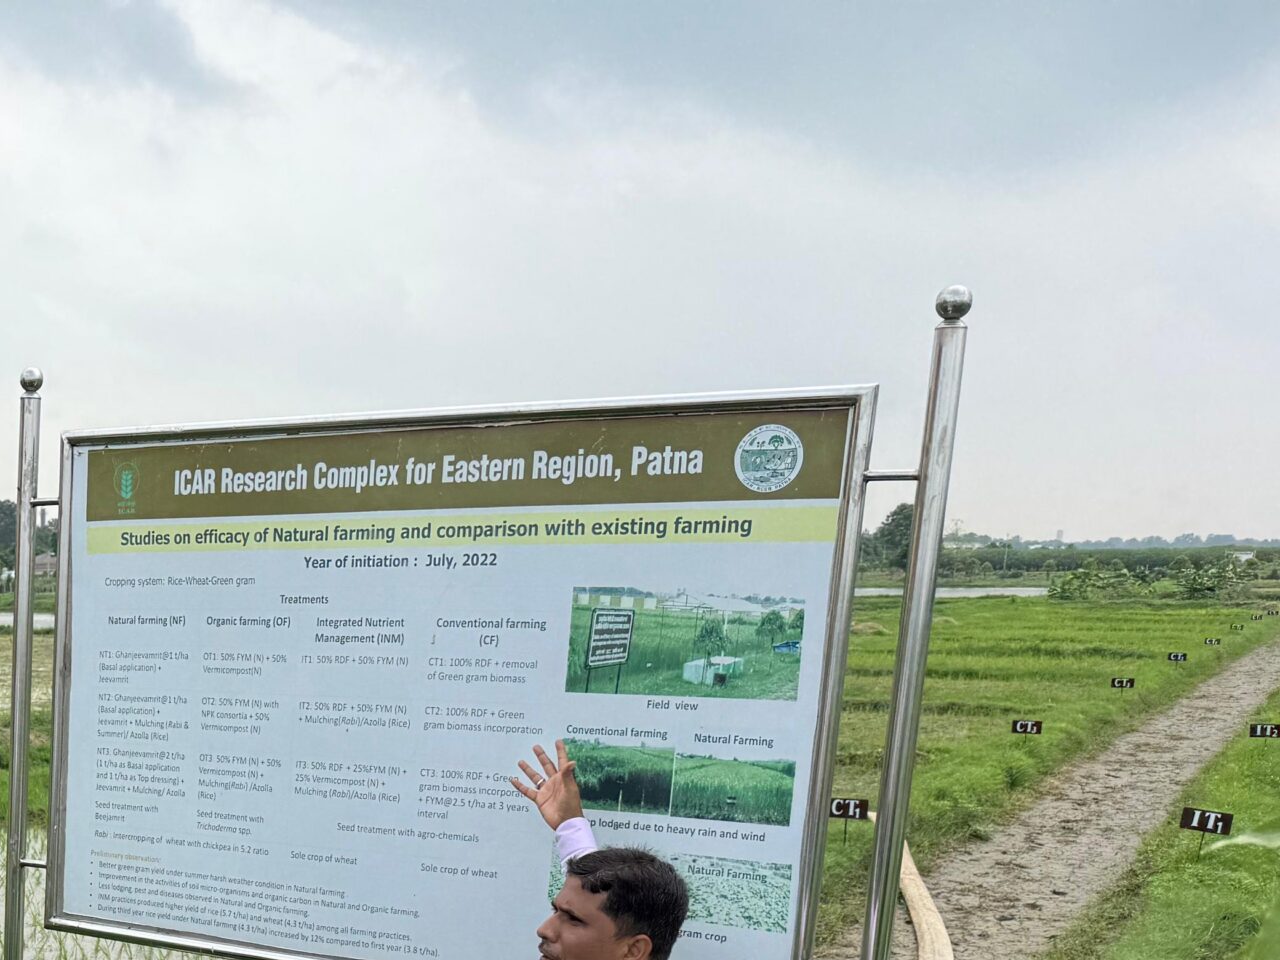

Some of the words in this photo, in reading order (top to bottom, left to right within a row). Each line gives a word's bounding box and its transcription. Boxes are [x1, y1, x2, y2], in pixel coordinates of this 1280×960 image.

[174, 468, 215, 495] ICAR
[221, 464, 307, 493] Research
[314, 460, 398, 493] Complex
[405, 458, 435, 484] for
[442, 455, 524, 483] Eastern
[532, 449, 621, 485] Region,
[631, 445, 703, 476] Patna
[121, 530, 170, 546] Studies
[174, 533, 190, 544] on
[196, 529, 249, 547] efficacy
[254, 528, 269, 542] of
[273, 526, 328, 542] Natural
[334, 524, 395, 543] farming
[401, 523, 431, 539] and
[437, 521, 539, 541] comparison
[545, 518, 585, 536] with
[592, 517, 667, 538] existing
[674, 516, 752, 537] farming
[304, 557, 332, 568] Year
[335, 556, 348, 568] of
[351, 554, 408, 568] initiation
[426, 554, 457, 569] July,
[462, 553, 497, 567] 2022
[105, 577, 135, 587] Cropping
[138, 578, 165, 587] system:
[168, 576, 233, 586] Rice-Wheat-Green
[236, 577, 255, 587] gram
[280, 595, 328, 604] Treatments
[108, 616, 136, 625] Natural
[138, 616, 167, 626] farming
[170, 616, 185, 627] (NF)
[207, 617, 237, 627] Organic
[239, 617, 270, 628] farming
[273, 617, 291, 628] (OF)
[317, 617, 362, 629] Integrated
[365, 618, 404, 627] Nutrient
[437, 618, 503, 628] Conventional
[506, 619, 547, 631] farming
[315, 634, 374, 645] Management
[377, 634, 404, 645] (INM)
[479, 635, 499, 647] (CF)
[221, 653, 235, 661] 50%
[237, 653, 252, 661] FYM
[272, 655, 287, 663] 50%
[317, 656, 332, 664] 50%
[334, 656, 349, 664] RDF
[358, 656, 374, 665] 50%
[377, 657, 394, 665] FYM
[396, 656, 408, 666] (N)
[429, 658, 446, 666] CT1:
[450, 658, 472, 667] 100%
[475, 659, 492, 667] RDF
[502, 660, 537, 669] removal
[428, 672, 437, 680] of
[438, 672, 463, 681] Green
[466, 674, 487, 683] gram
[490, 674, 526, 683] biomass
[314, 702, 330, 711] 50%
[332, 703, 347, 711] RDF
[357, 704, 373, 713] 50%
[375, 705, 392, 713] FYM
[395, 705, 407, 715] (N)
[647, 700, 669, 710] Field
[675, 702, 698, 711] view
[217, 711, 247, 720] consortia
[255, 712, 270, 721] 50%
[425, 707, 443, 715] CT2:
[446, 707, 468, 716] 100%
[471, 709, 488, 717] RDF
[498, 710, 524, 719] Green
[201, 723, 248, 734] Vermicompost
[388, 718, 410, 729] (Rice)
[424, 722, 445, 731] gram
[447, 722, 482, 731] biomass
[484, 724, 543, 735] incorporation
[566, 725, 628, 737] Conventional
[630, 727, 667, 740] farming
[1256, 725, 1278, 737] IT2
[694, 733, 731, 744] Natural
[733, 735, 774, 748] Farming
[311, 761, 326, 771] 50%
[329, 763, 344, 772] RDF
[388, 766, 400, 776] (N)
[420, 769, 438, 777] CT3:
[441, 770, 463, 779] 100%
[466, 771, 483, 780] RDF
[295, 774, 310, 783] 25%
[312, 775, 365, 787] Vermicompost
[367, 777, 379, 788] (N)
[295, 787, 327, 798] Mulching
[378, 792, 400, 803] (Rice)
[419, 783, 440, 792] gram
[442, 784, 477, 794] biomass
[468, 799, 486, 809] t/ha
[488, 801, 496, 809] at
[499, 801, 504, 809] 3
[506, 803, 529, 813] years
[832, 799, 860, 818] CT1
[197, 810, 213, 819] Seed
[215, 811, 247, 822] treatment
[249, 813, 264, 823] with
[418, 810, 448, 819] interval
[1191, 810, 1223, 833] IT1
[337, 823, 355, 832] Seed
[357, 825, 396, 836] treatment
[398, 828, 415, 837] with
[418, 831, 479, 842] agro-chemicals
[599, 818, 630, 831] lodged
[633, 821, 651, 832] due
[654, 823, 664, 833] to
[666, 824, 695, 837] heavy
[698, 827, 717, 837] rain
[719, 828, 738, 840] and
[741, 832, 765, 842] wind
[291, 851, 306, 860] Sole
[307, 854, 323, 863] crop
[325, 854, 332, 863] of
[334, 855, 357, 865] wheat
[421, 863, 438, 873] Sole
[440, 866, 458, 875] crop
[460, 867, 469, 876] of
[471, 869, 498, 879] wheat
[687, 864, 724, 877] Natural
[727, 869, 767, 884] Farming
[321, 899, 345, 909] Natural
[347, 902, 360, 911] and
[362, 904, 389, 915] Organic
[316, 924, 339, 935] among
[350, 927, 377, 938] farming
[705, 933, 727, 943] crop
